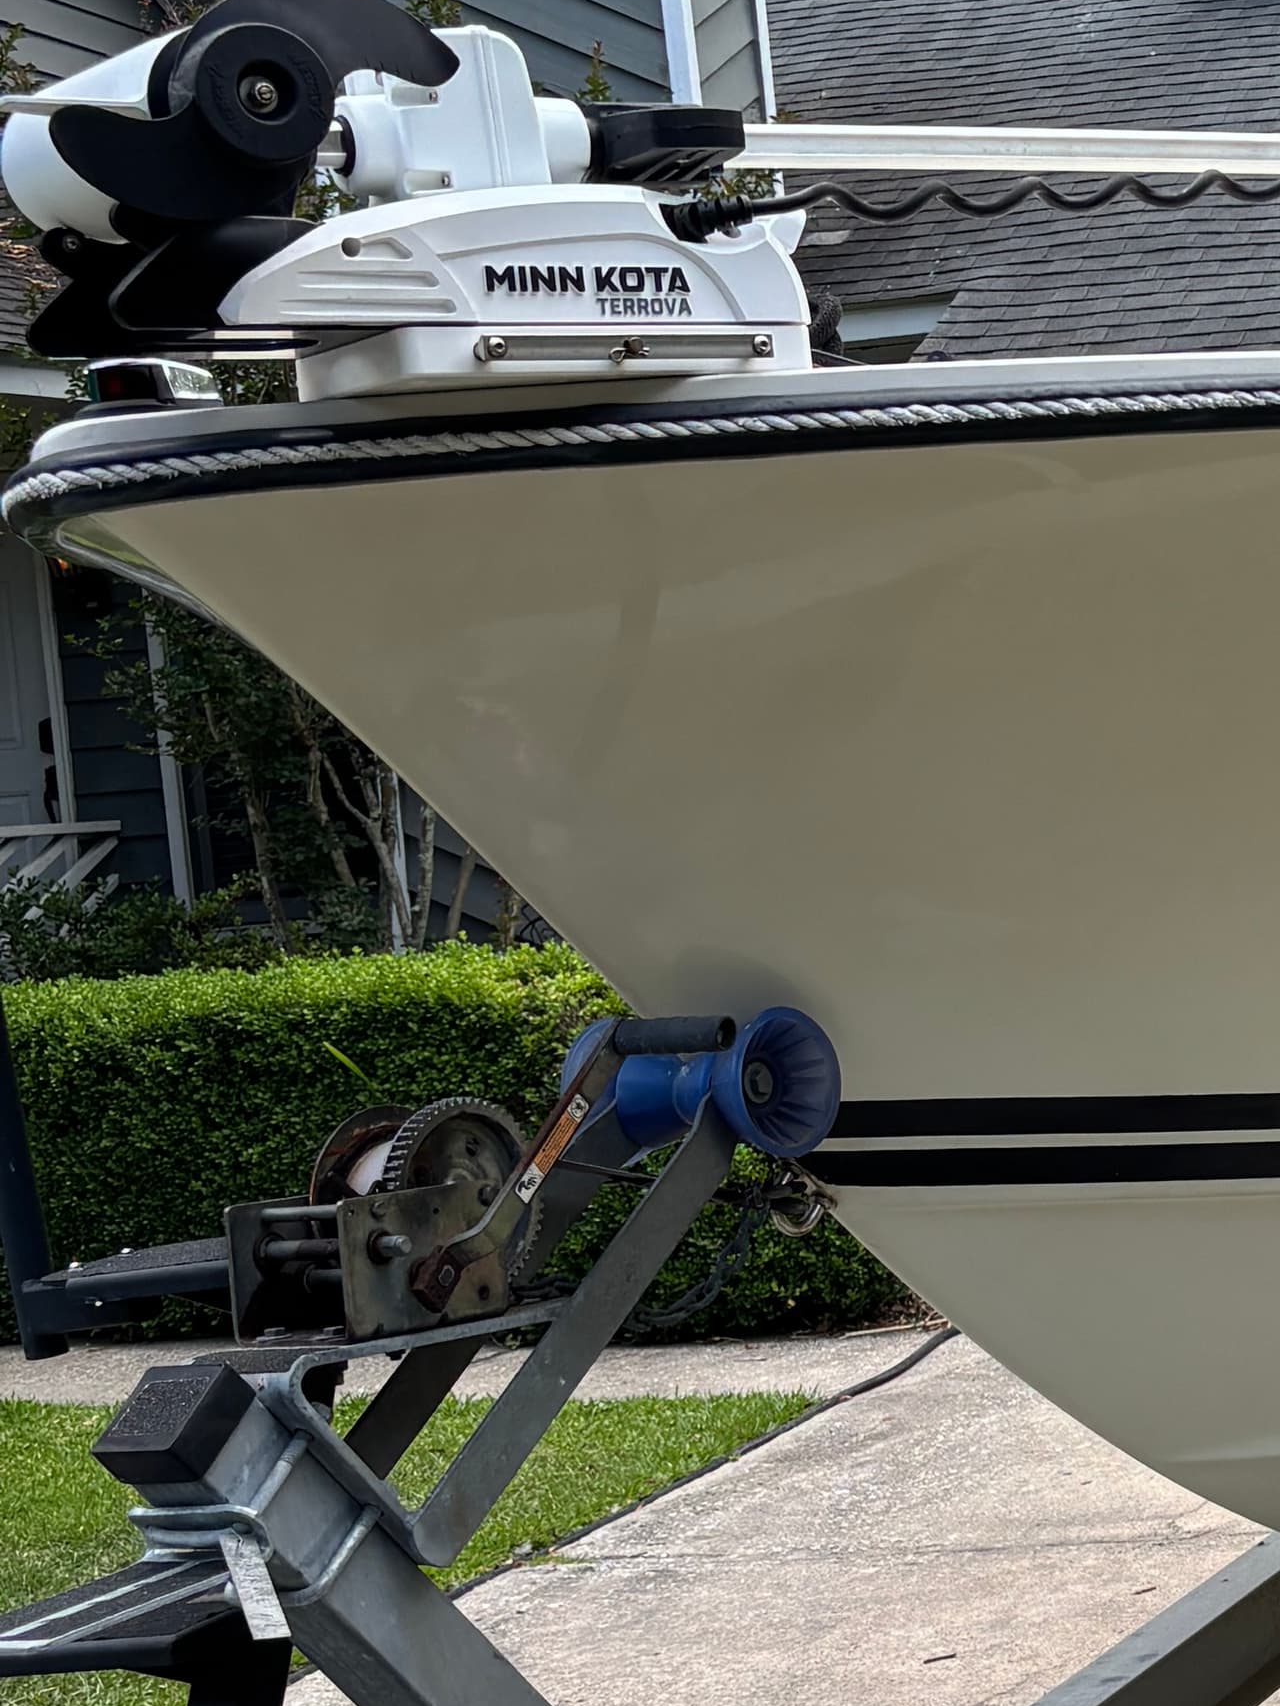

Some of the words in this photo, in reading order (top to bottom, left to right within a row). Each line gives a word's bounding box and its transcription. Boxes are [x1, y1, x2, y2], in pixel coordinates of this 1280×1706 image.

[485, 265, 586, 293] MINN
[594, 266, 691, 293] KOTA
[596, 297, 692, 316] TERROVA
